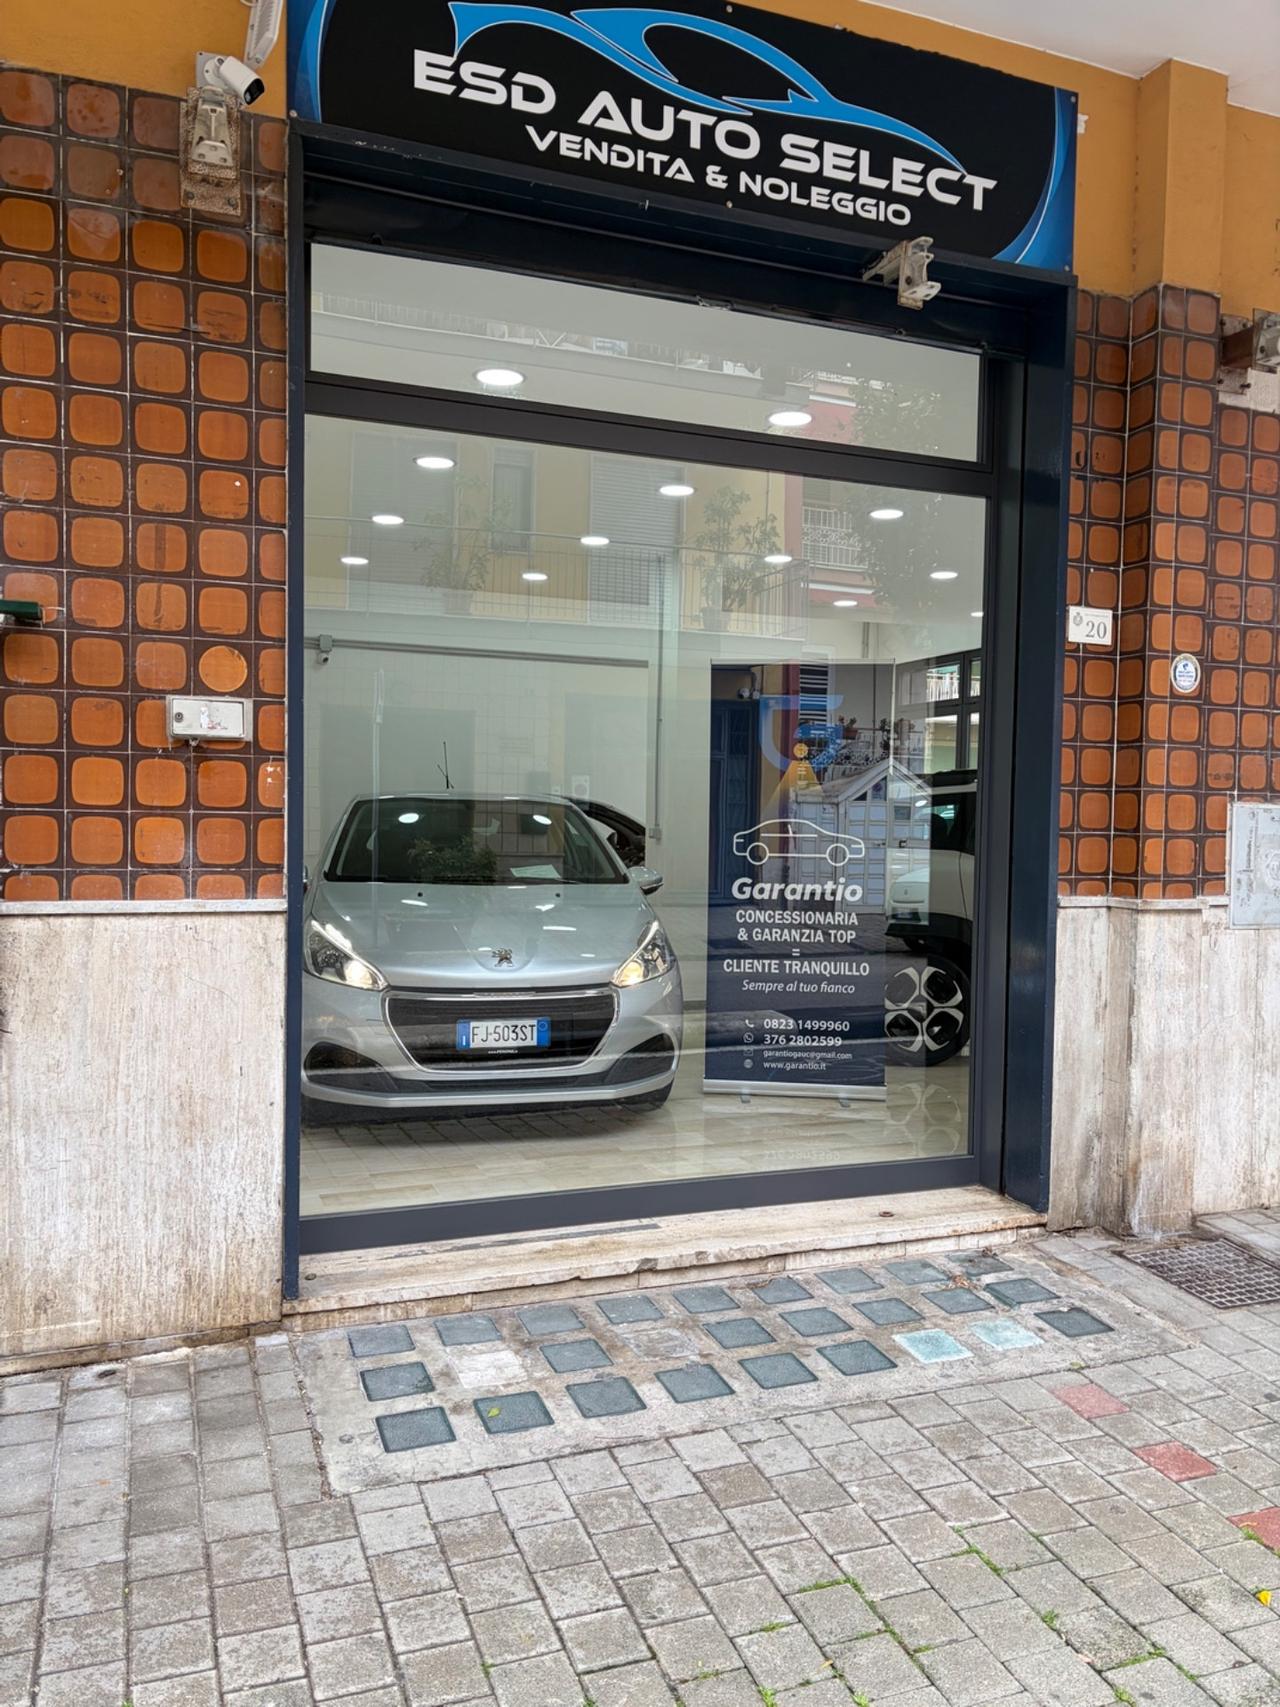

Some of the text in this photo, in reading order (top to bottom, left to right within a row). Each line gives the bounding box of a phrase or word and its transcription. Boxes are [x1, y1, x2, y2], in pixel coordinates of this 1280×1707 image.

[414, 49, 997, 211] ESD AUTO SELECT
[525, 125, 911, 226] VENDITA & NOLEGGIO
[1086, 620, 1107, 639] 20
[732, 877, 863, 902] Garantio
[735, 910, 859, 926] CONCESSIONARIA
[737, 928, 856, 944] & GARANZIA TOP
[723, 959, 870, 977] CLIENTE TRANQUILLO
[742, 979, 855, 995] Sempre al tuo fianco
[764, 1019, 850, 1032] 0823 1499960
[764, 1034, 842, 1047] 376 2802599
[763, 1061, 826, 1071] www.garantio.it
